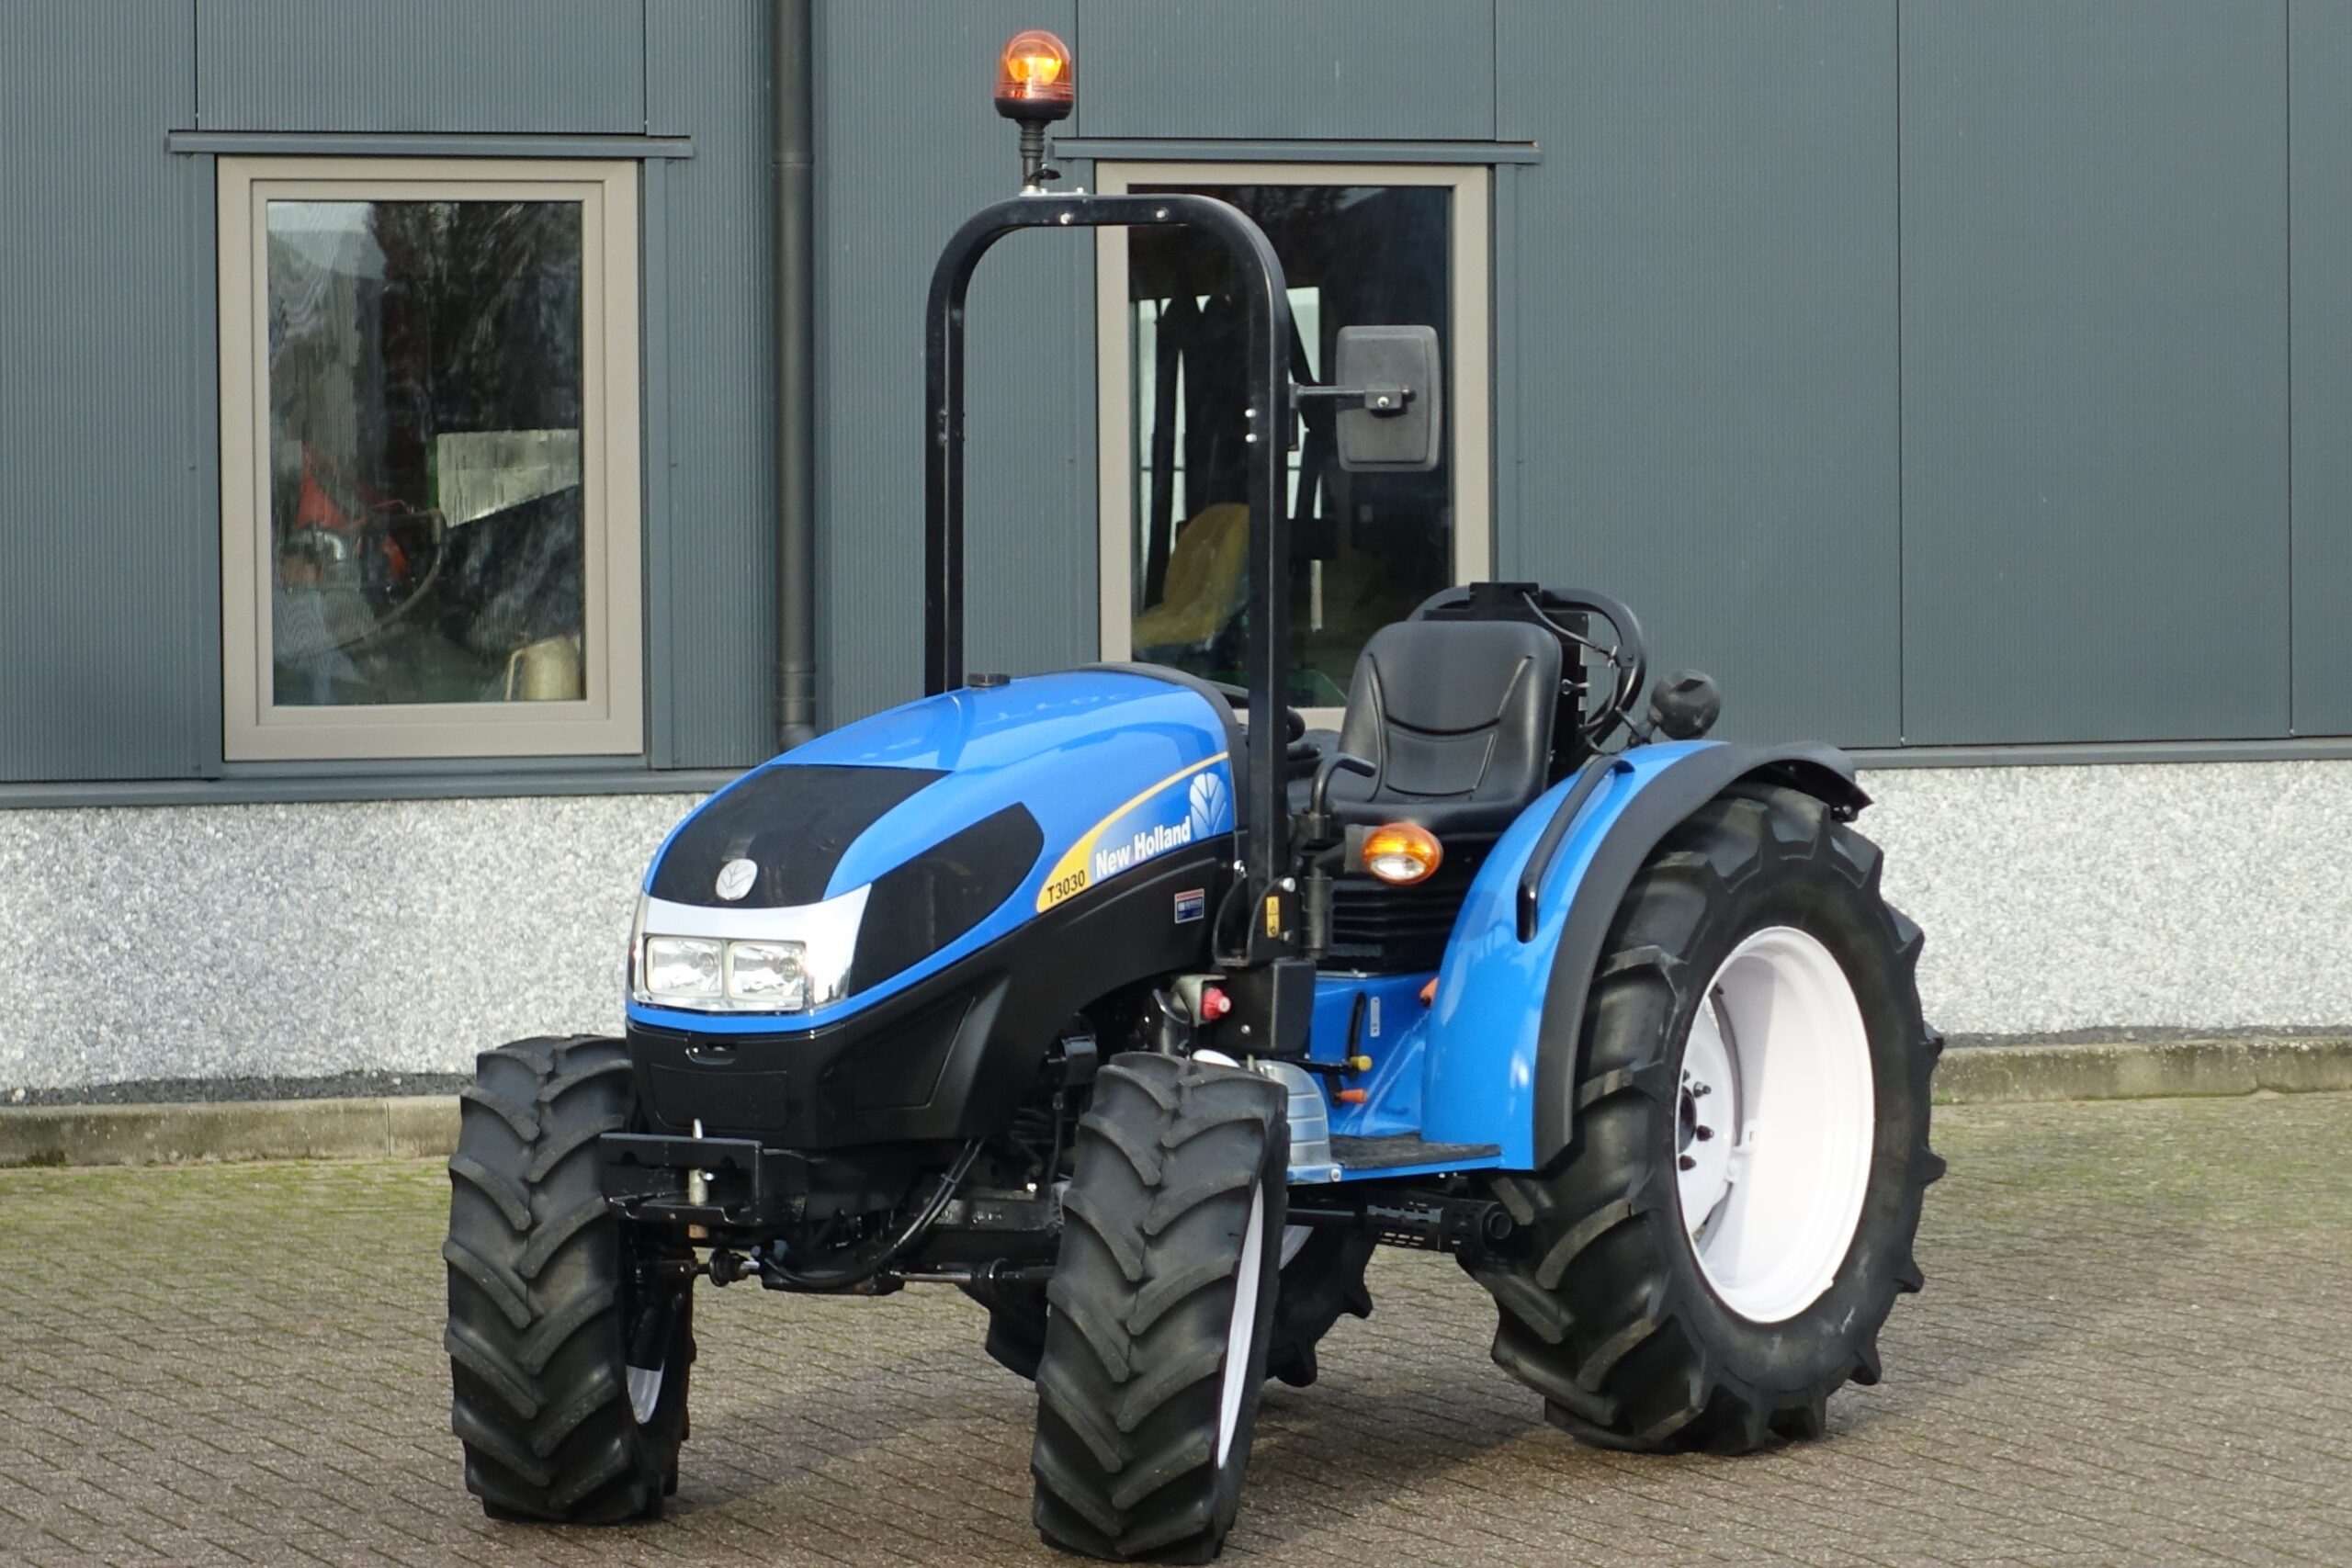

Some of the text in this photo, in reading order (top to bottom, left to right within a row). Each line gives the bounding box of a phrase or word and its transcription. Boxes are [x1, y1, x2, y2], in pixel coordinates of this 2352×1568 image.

[1095, 815, 1192, 879] New Holland
[1046, 869, 1086, 903] T3030
